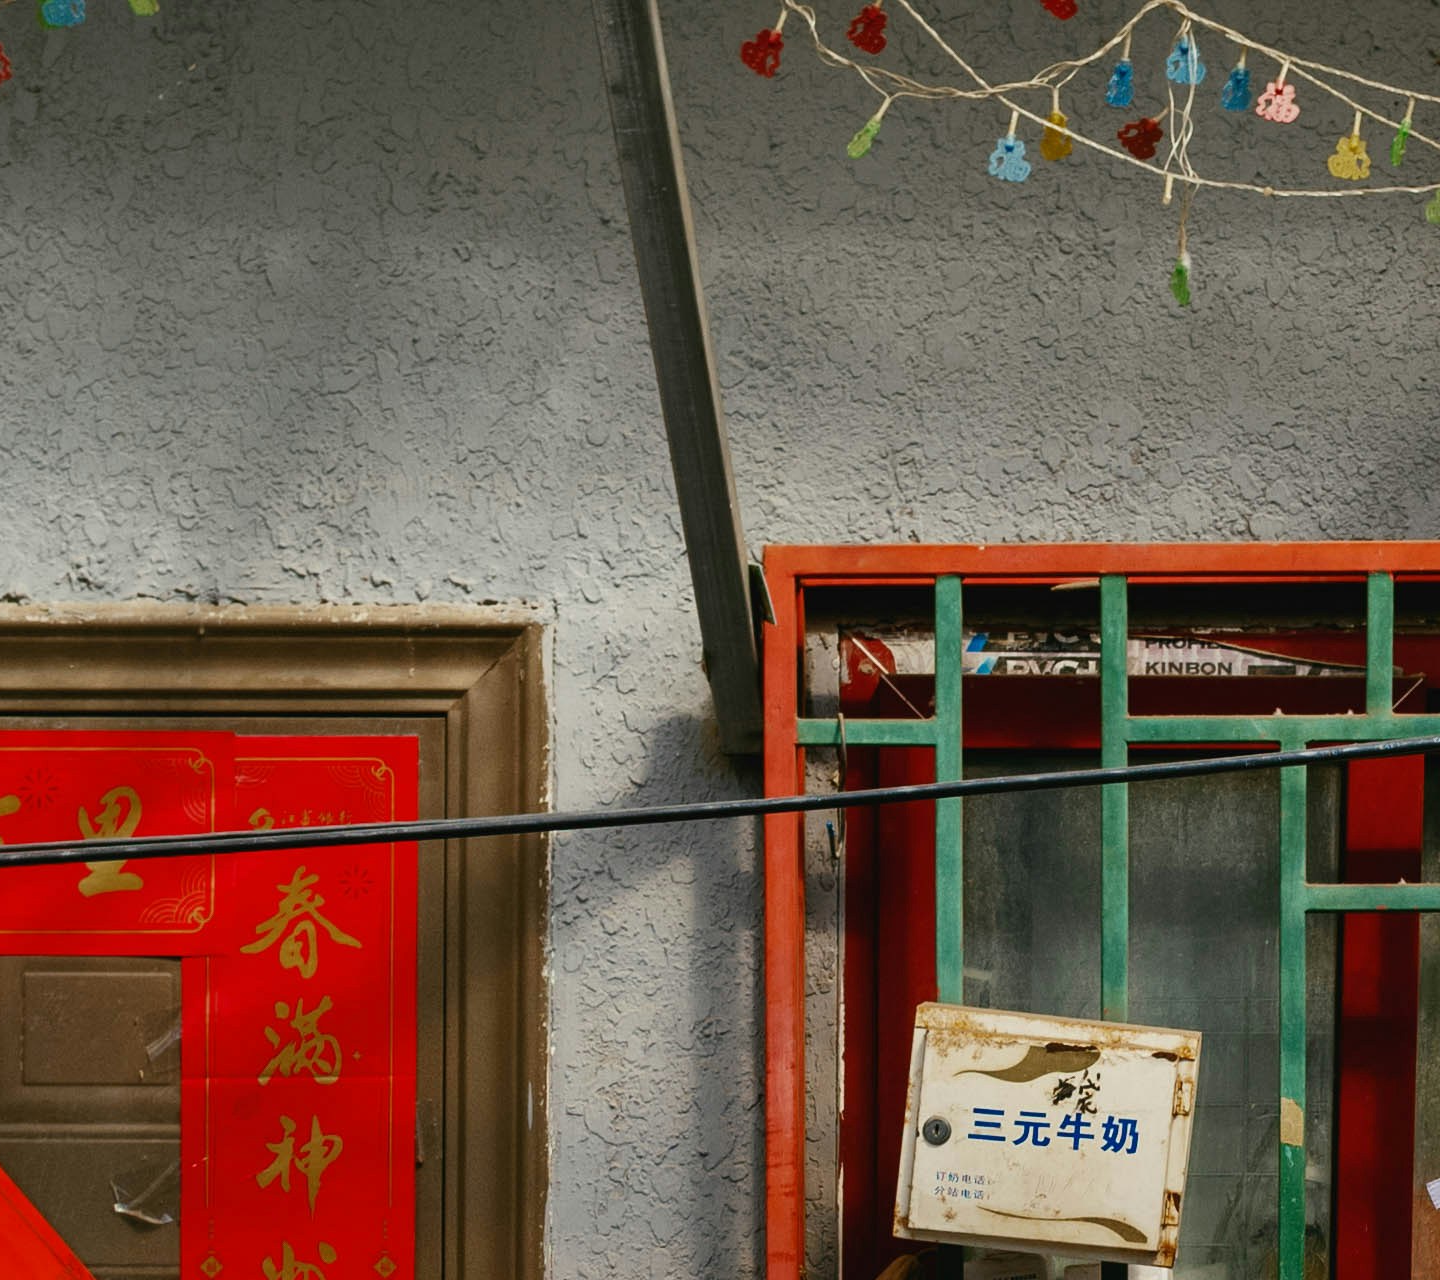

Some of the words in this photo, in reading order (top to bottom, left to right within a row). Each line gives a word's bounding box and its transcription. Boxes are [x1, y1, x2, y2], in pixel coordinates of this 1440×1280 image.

[1145, 662, 1233, 676] KINBON
[967, 1107, 1140, 1154] 三元牛奶
